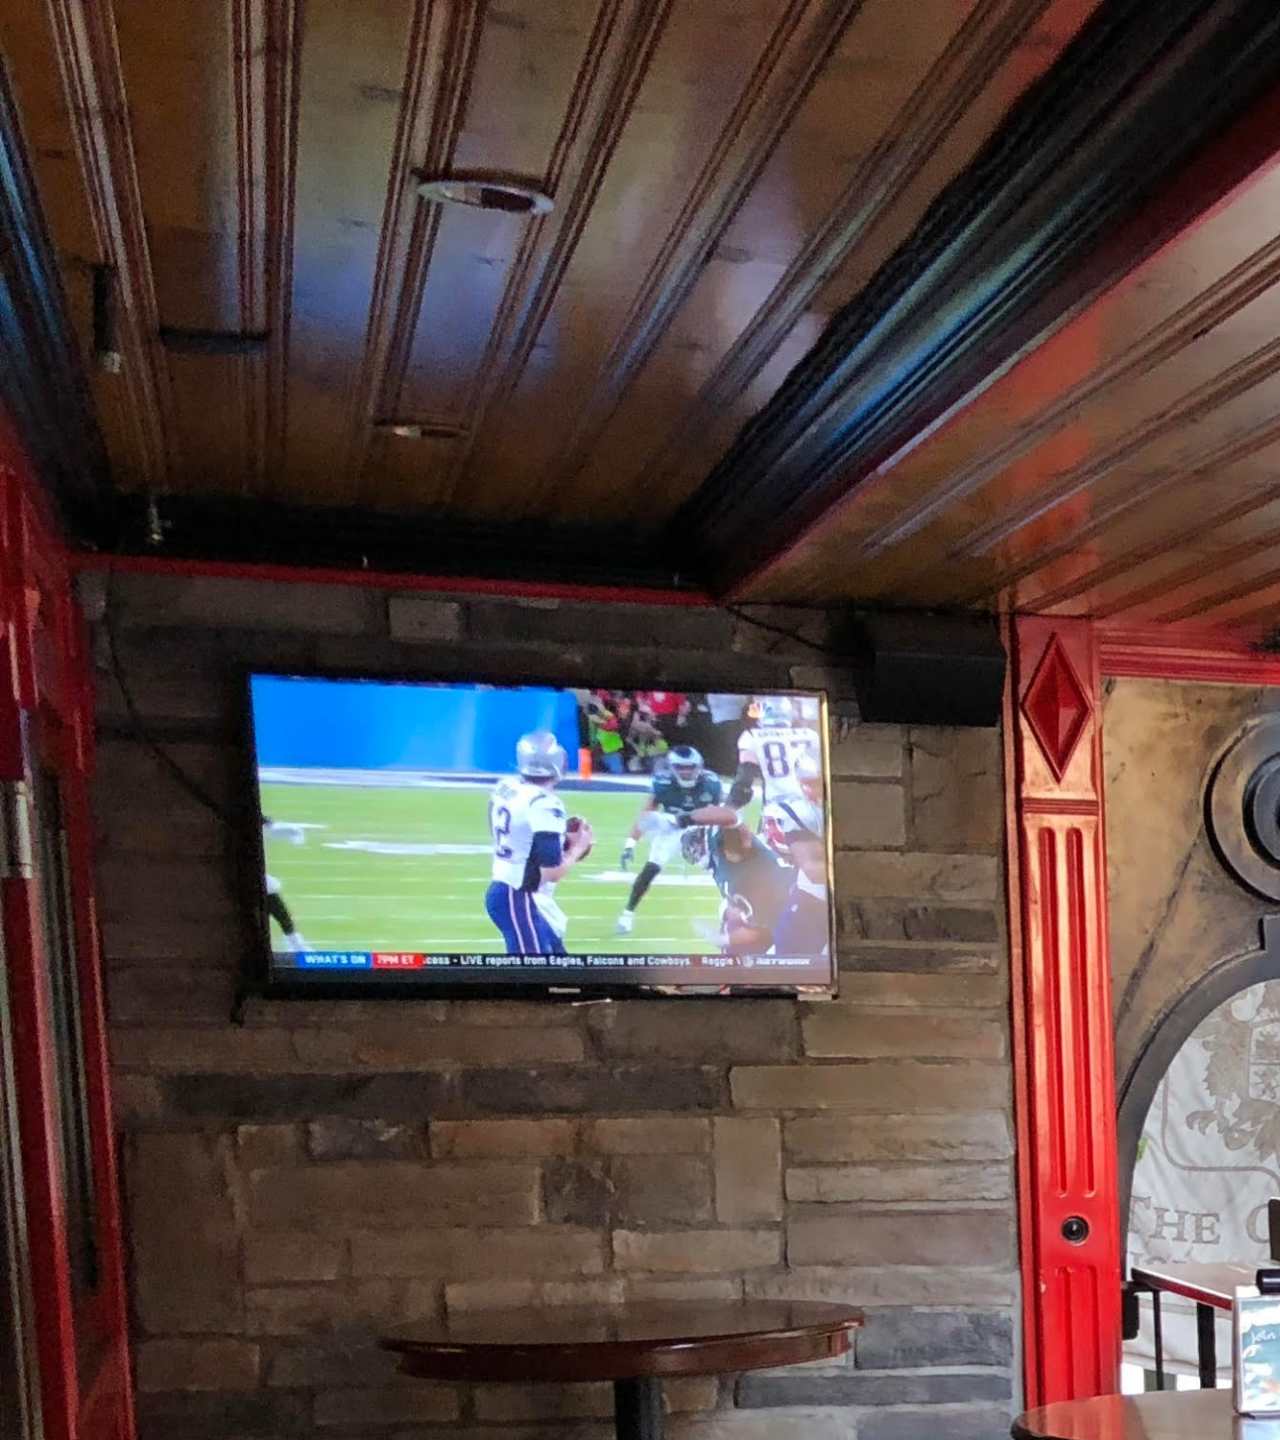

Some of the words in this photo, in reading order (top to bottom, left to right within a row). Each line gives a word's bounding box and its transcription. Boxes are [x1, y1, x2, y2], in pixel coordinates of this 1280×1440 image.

[461, 955, 482, 965] LIVE
[486, 956, 521, 967] reports
[524, 955, 547, 966] from
[549, 955, 584, 968] Eagles,
[587, 955, 624, 966] Falcons
[627, 956, 645, 966] and
[648, 956, 690, 968] Cowboys
